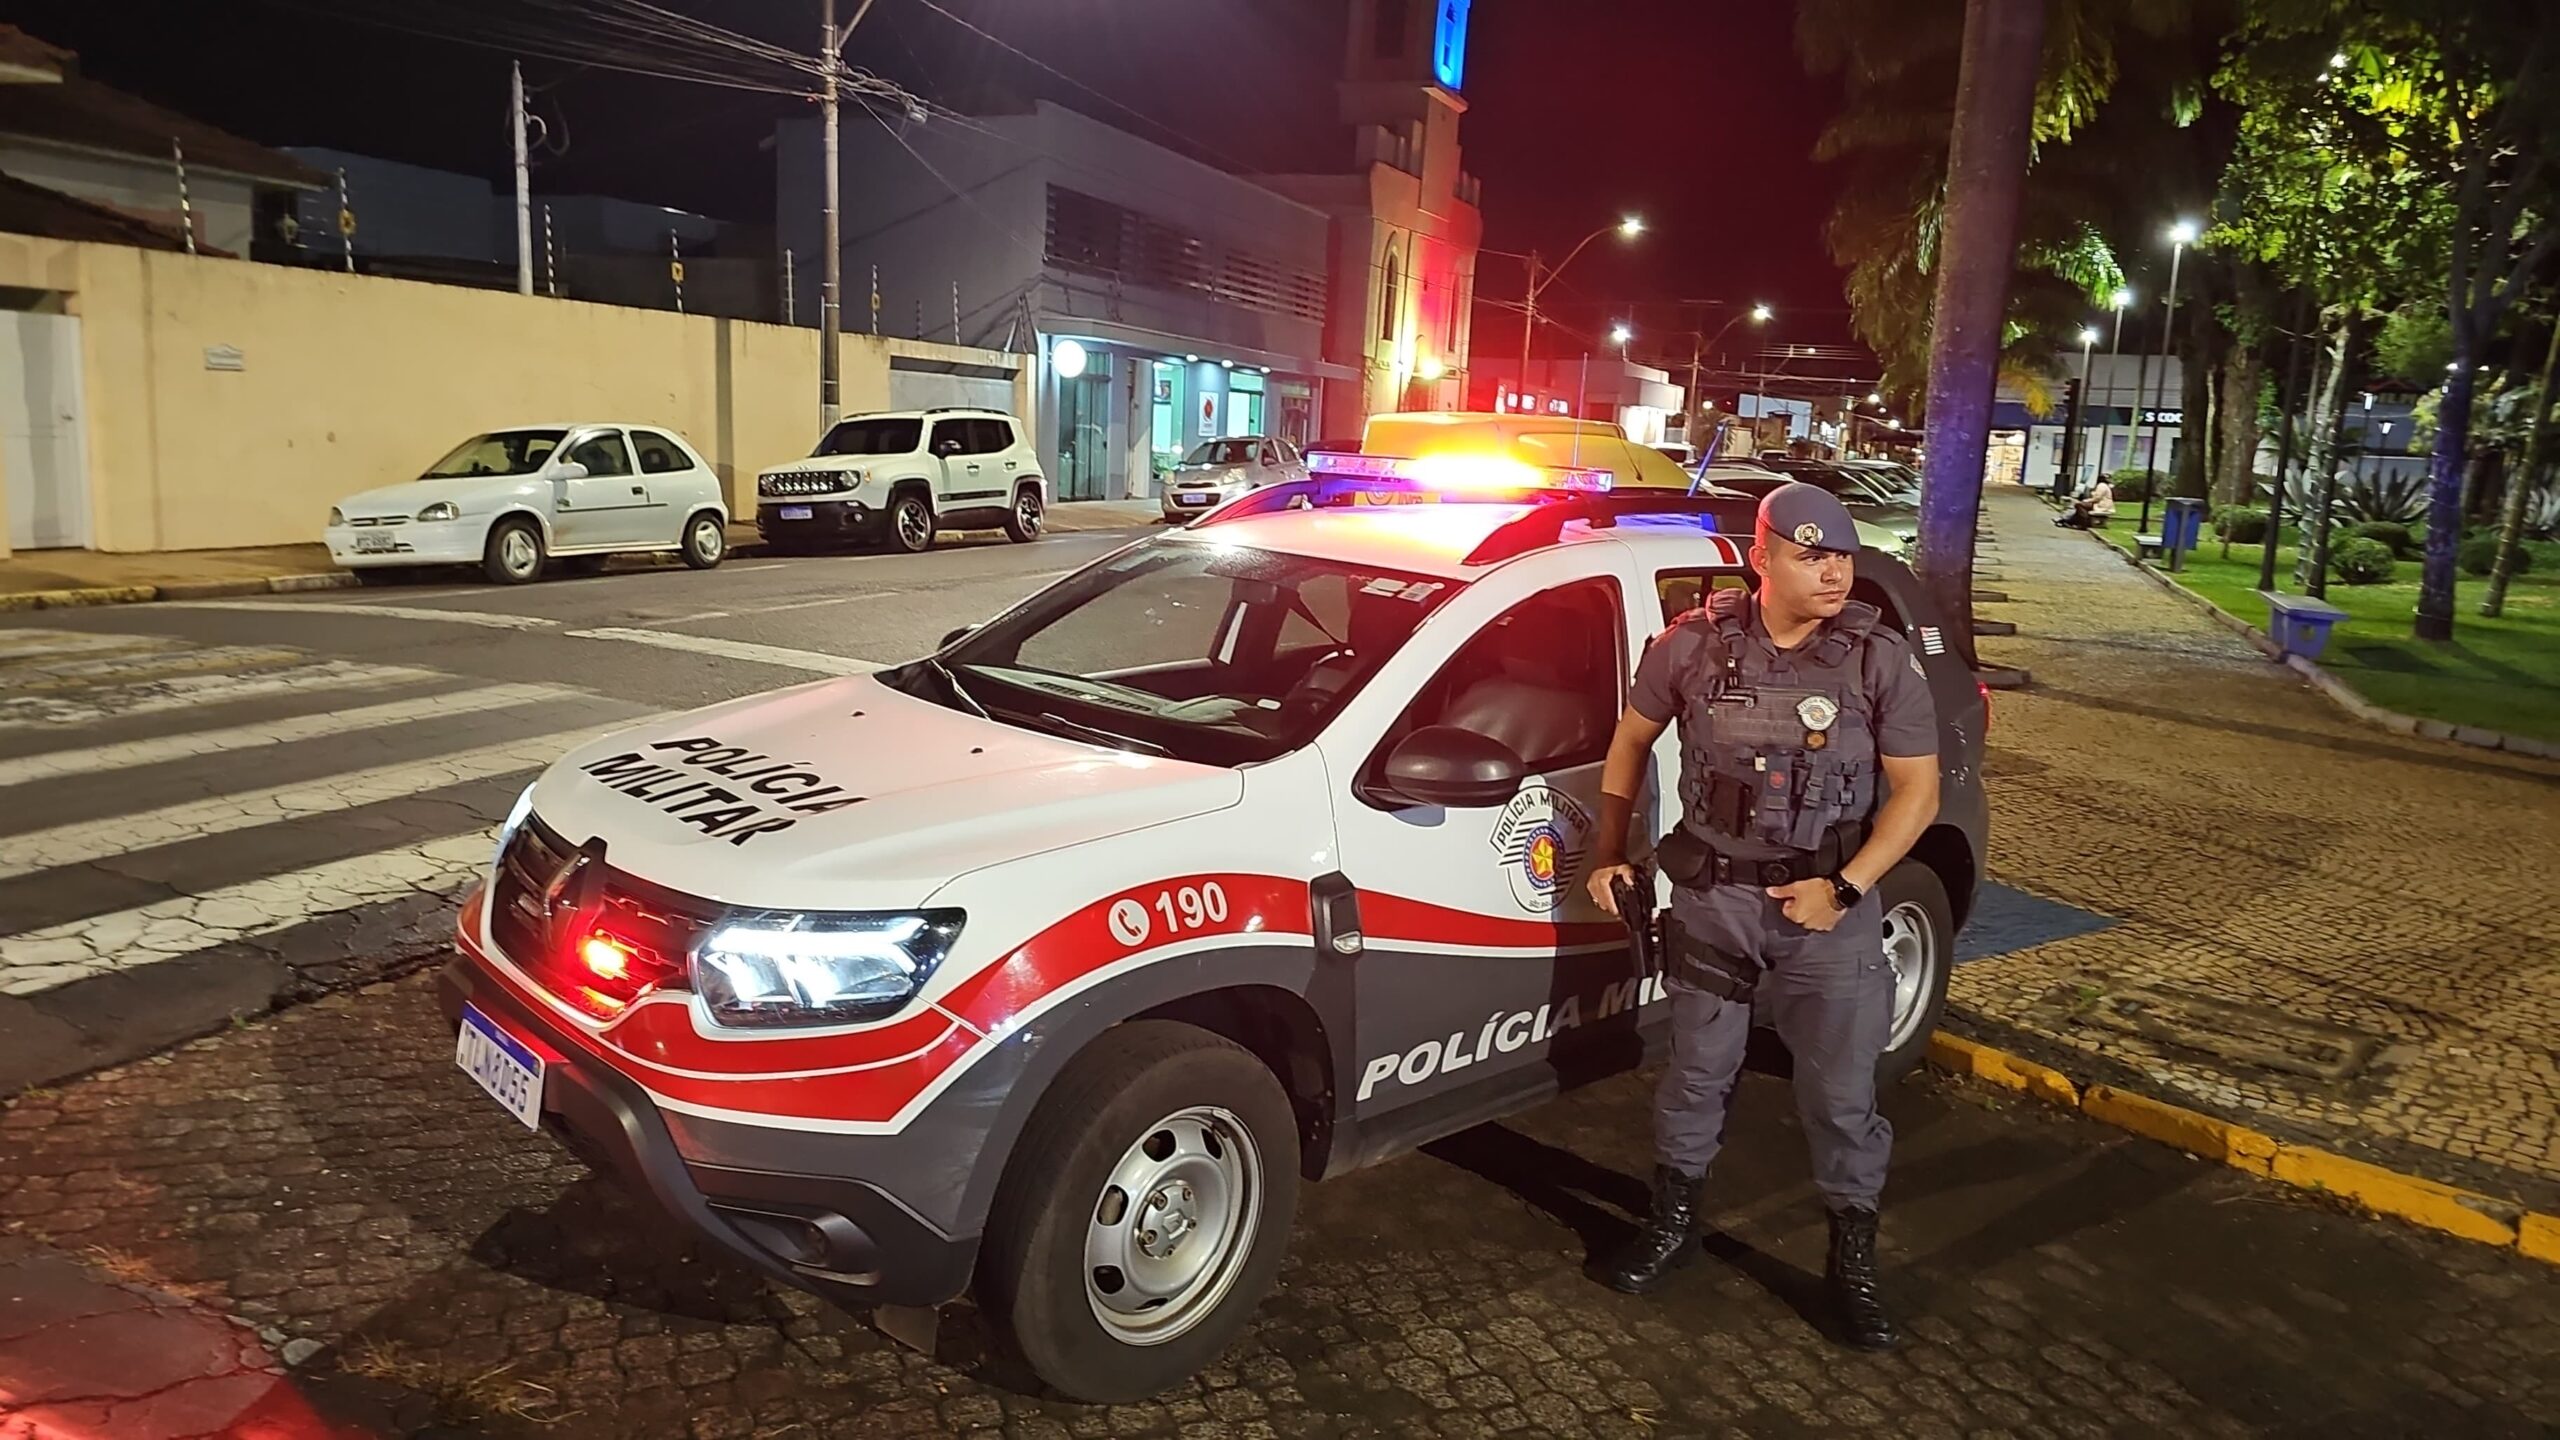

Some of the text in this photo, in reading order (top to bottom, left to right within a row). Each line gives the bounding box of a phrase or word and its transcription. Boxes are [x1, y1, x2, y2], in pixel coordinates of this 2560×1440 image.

[579, 752, 797, 847] MILITAR
[649, 737, 870, 815] POLÍCIA
[1539, 790, 1585, 834] MILITAR
[1155, 881, 1228, 933] 190
[1355, 968, 1669, 1102] POLÍCIA MIL
